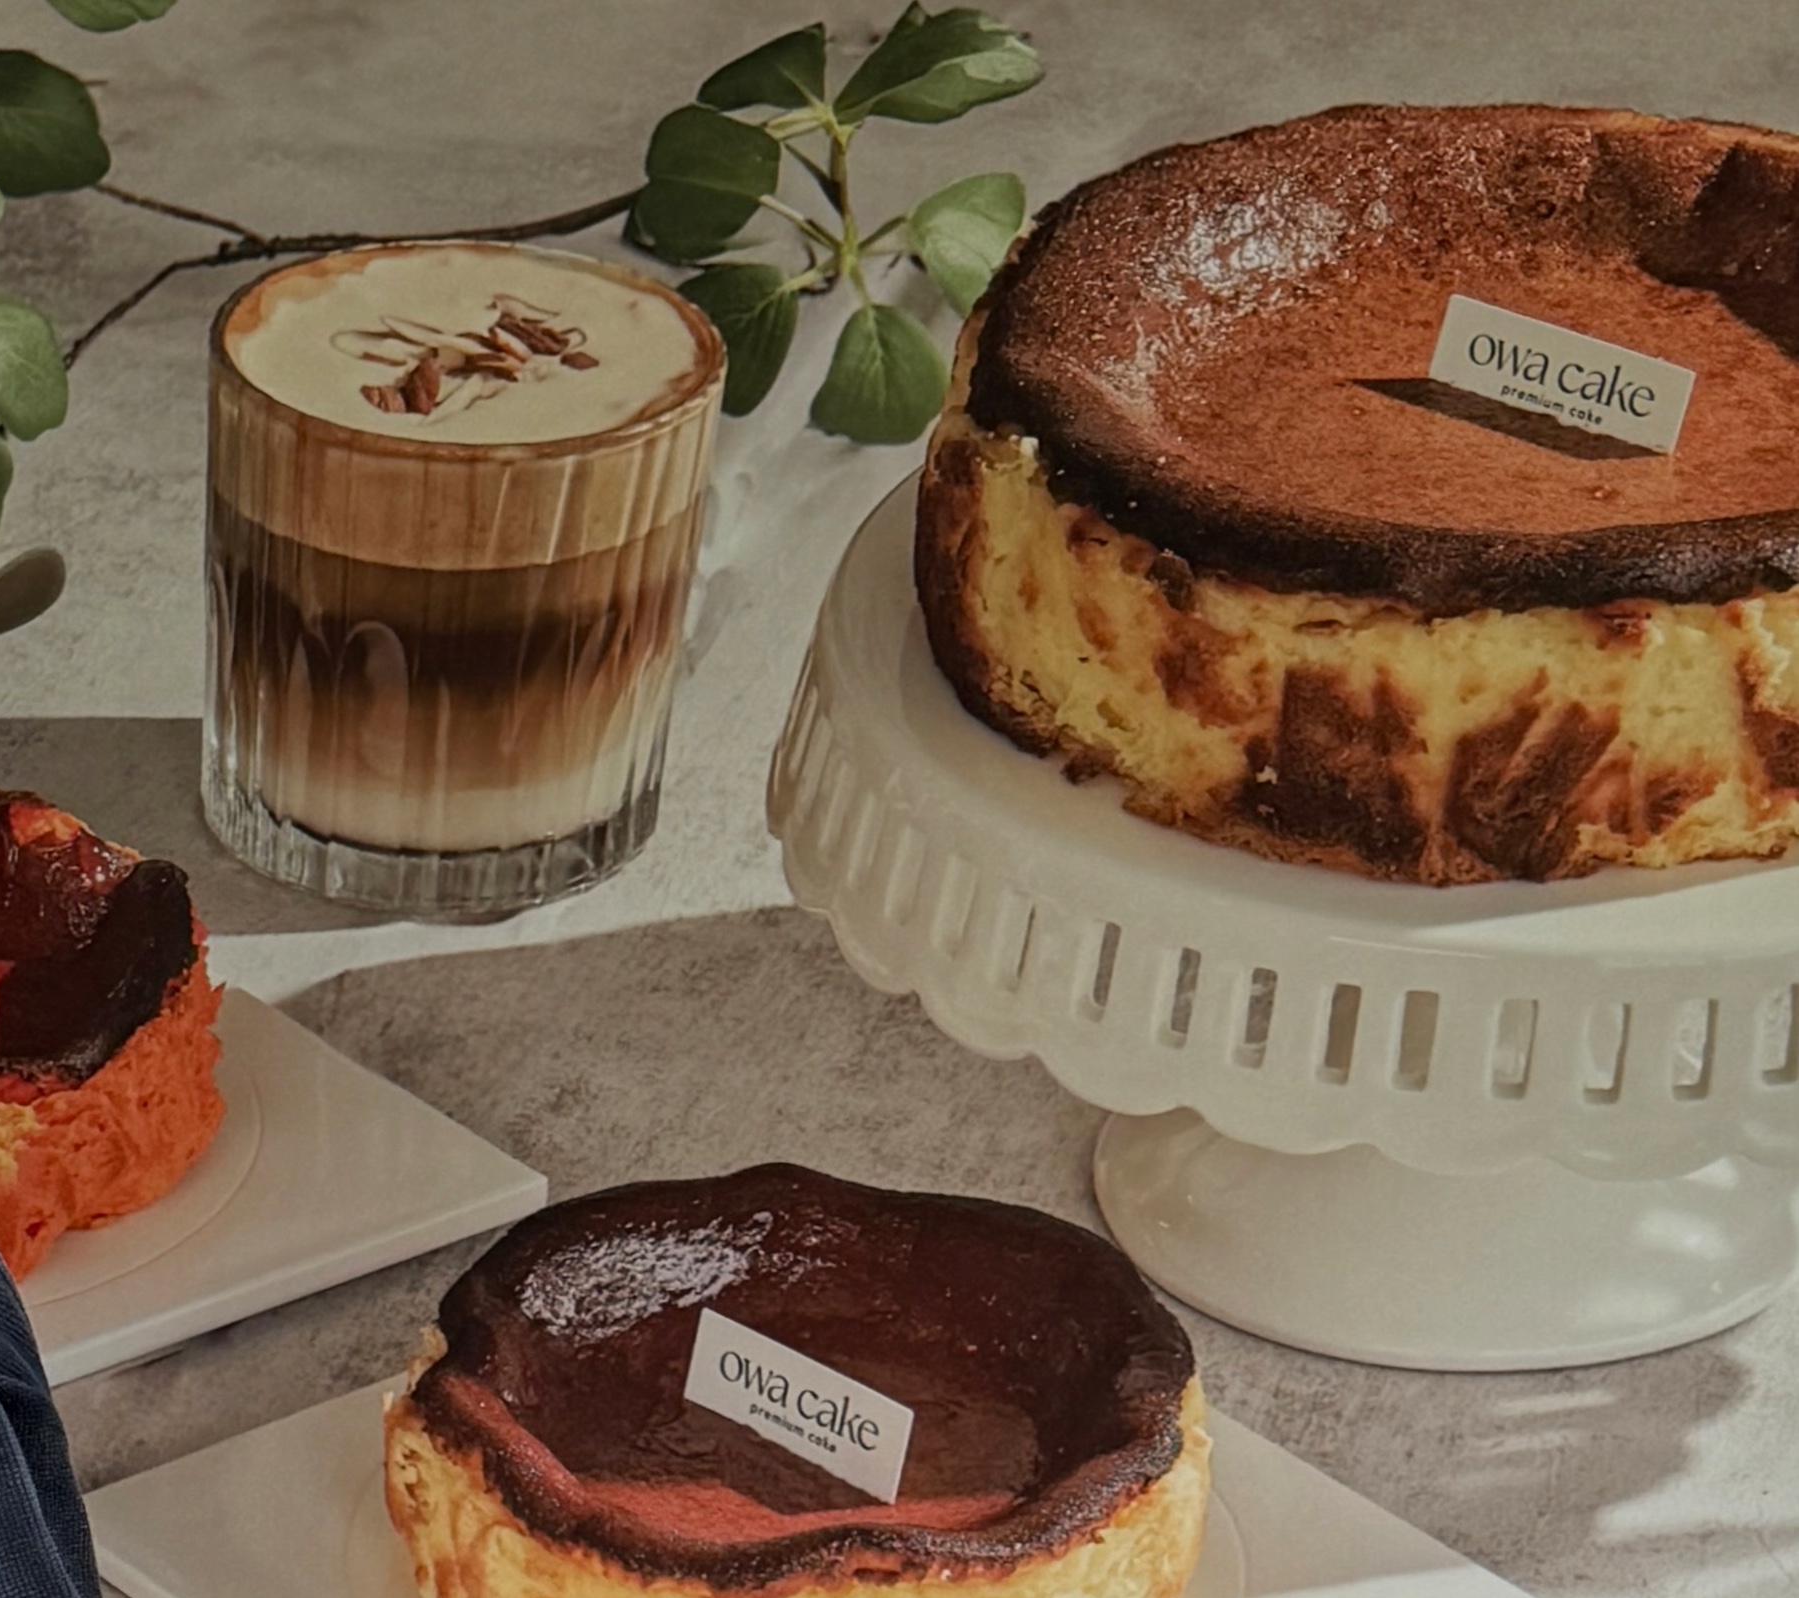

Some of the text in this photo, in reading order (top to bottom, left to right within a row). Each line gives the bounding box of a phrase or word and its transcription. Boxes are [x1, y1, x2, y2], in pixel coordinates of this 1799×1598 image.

[1467, 333, 1656, 418] owa cake
[1501, 383, 1604, 425] premium cake
[719, 1351, 880, 1451] owa cake
[748, 1403, 804, 1438] premium
